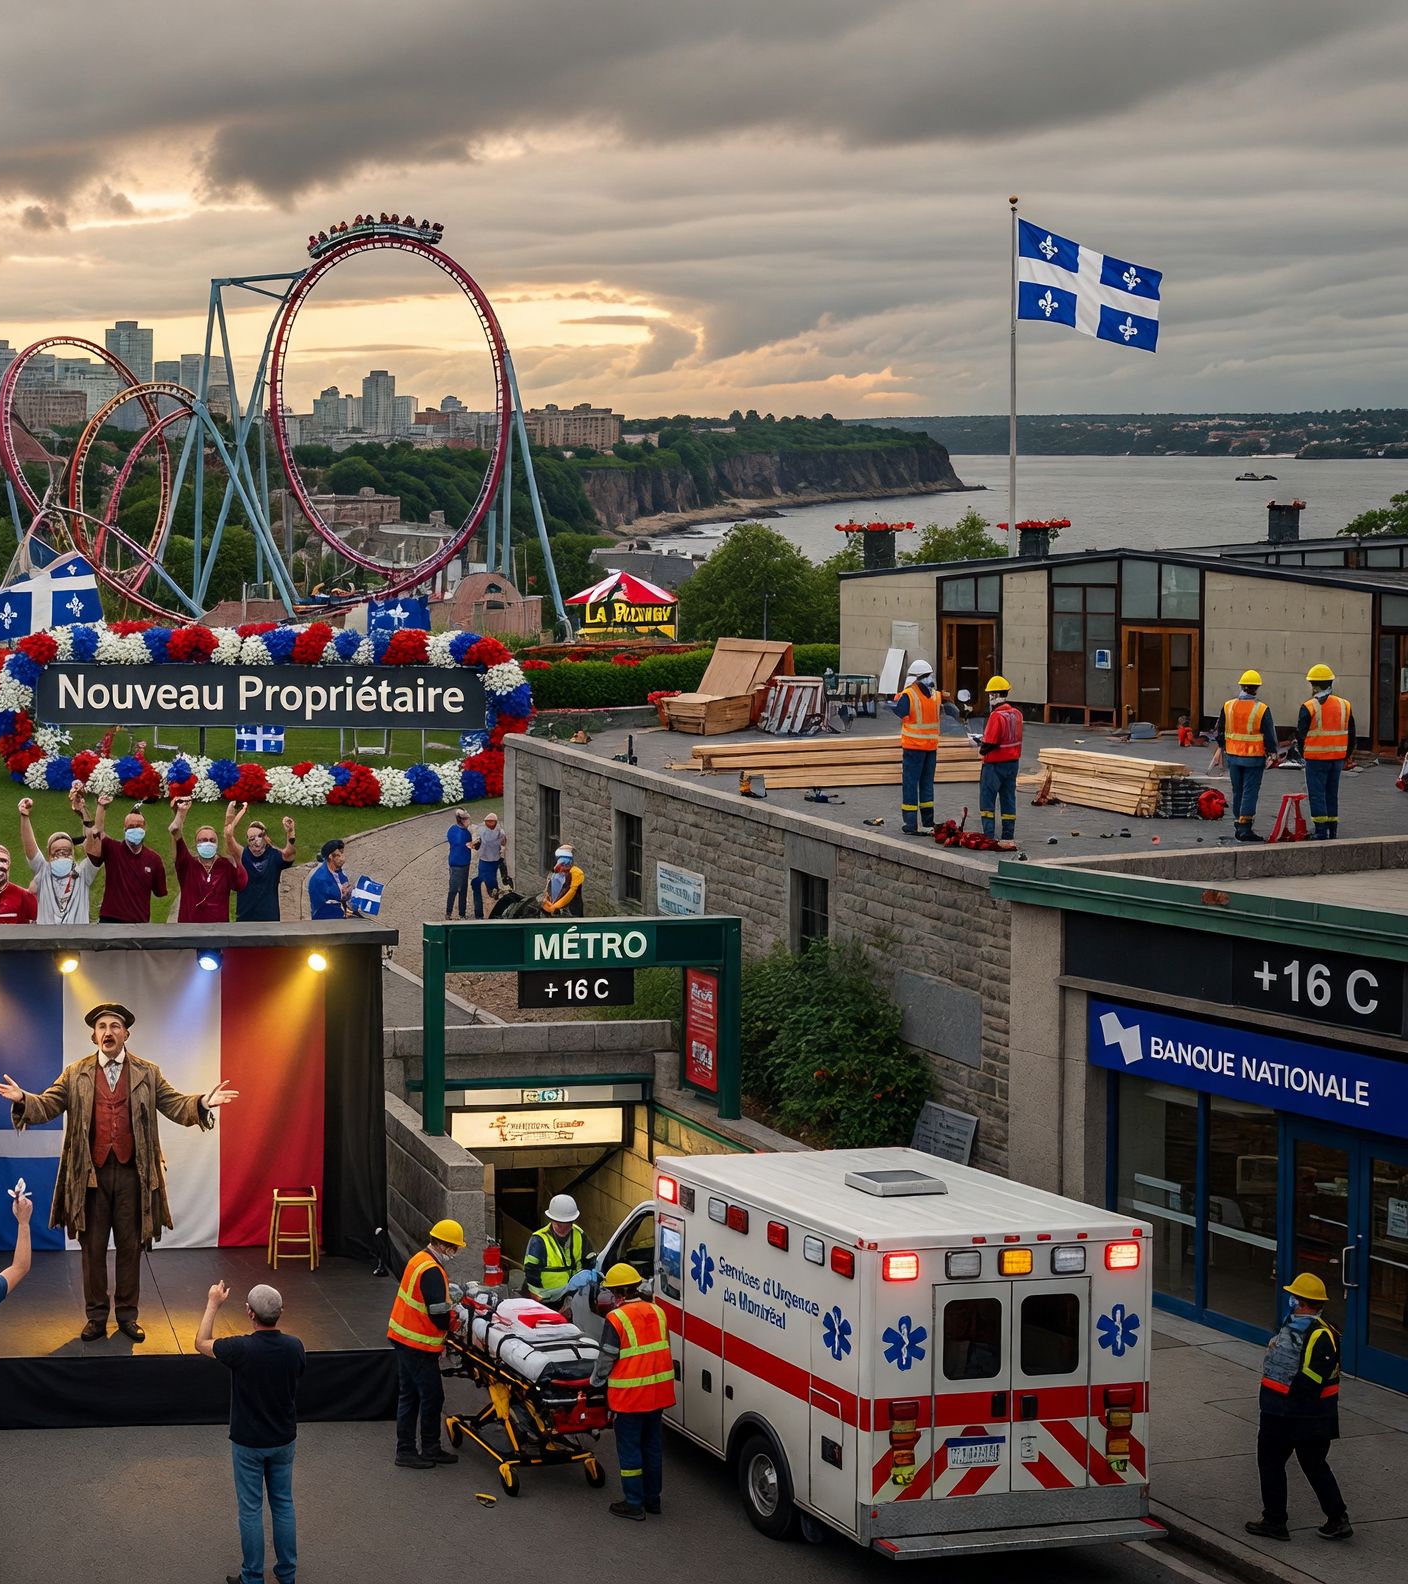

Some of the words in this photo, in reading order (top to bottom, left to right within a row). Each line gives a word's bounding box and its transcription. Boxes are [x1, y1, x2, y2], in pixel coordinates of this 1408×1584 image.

[57, 673, 224, 711] Nouveau
[238, 674, 465, 721] Propriétaire
[534, 925, 648, 961] MÉTRO
[594, 978, 609, 999] C
[1253, 959, 1332, 1008] +16
[1346, 969, 1379, 1015] C
[1150, 1036, 1235, 1077] BANQUE
[1241, 1055, 1370, 1107] NATIONALE
